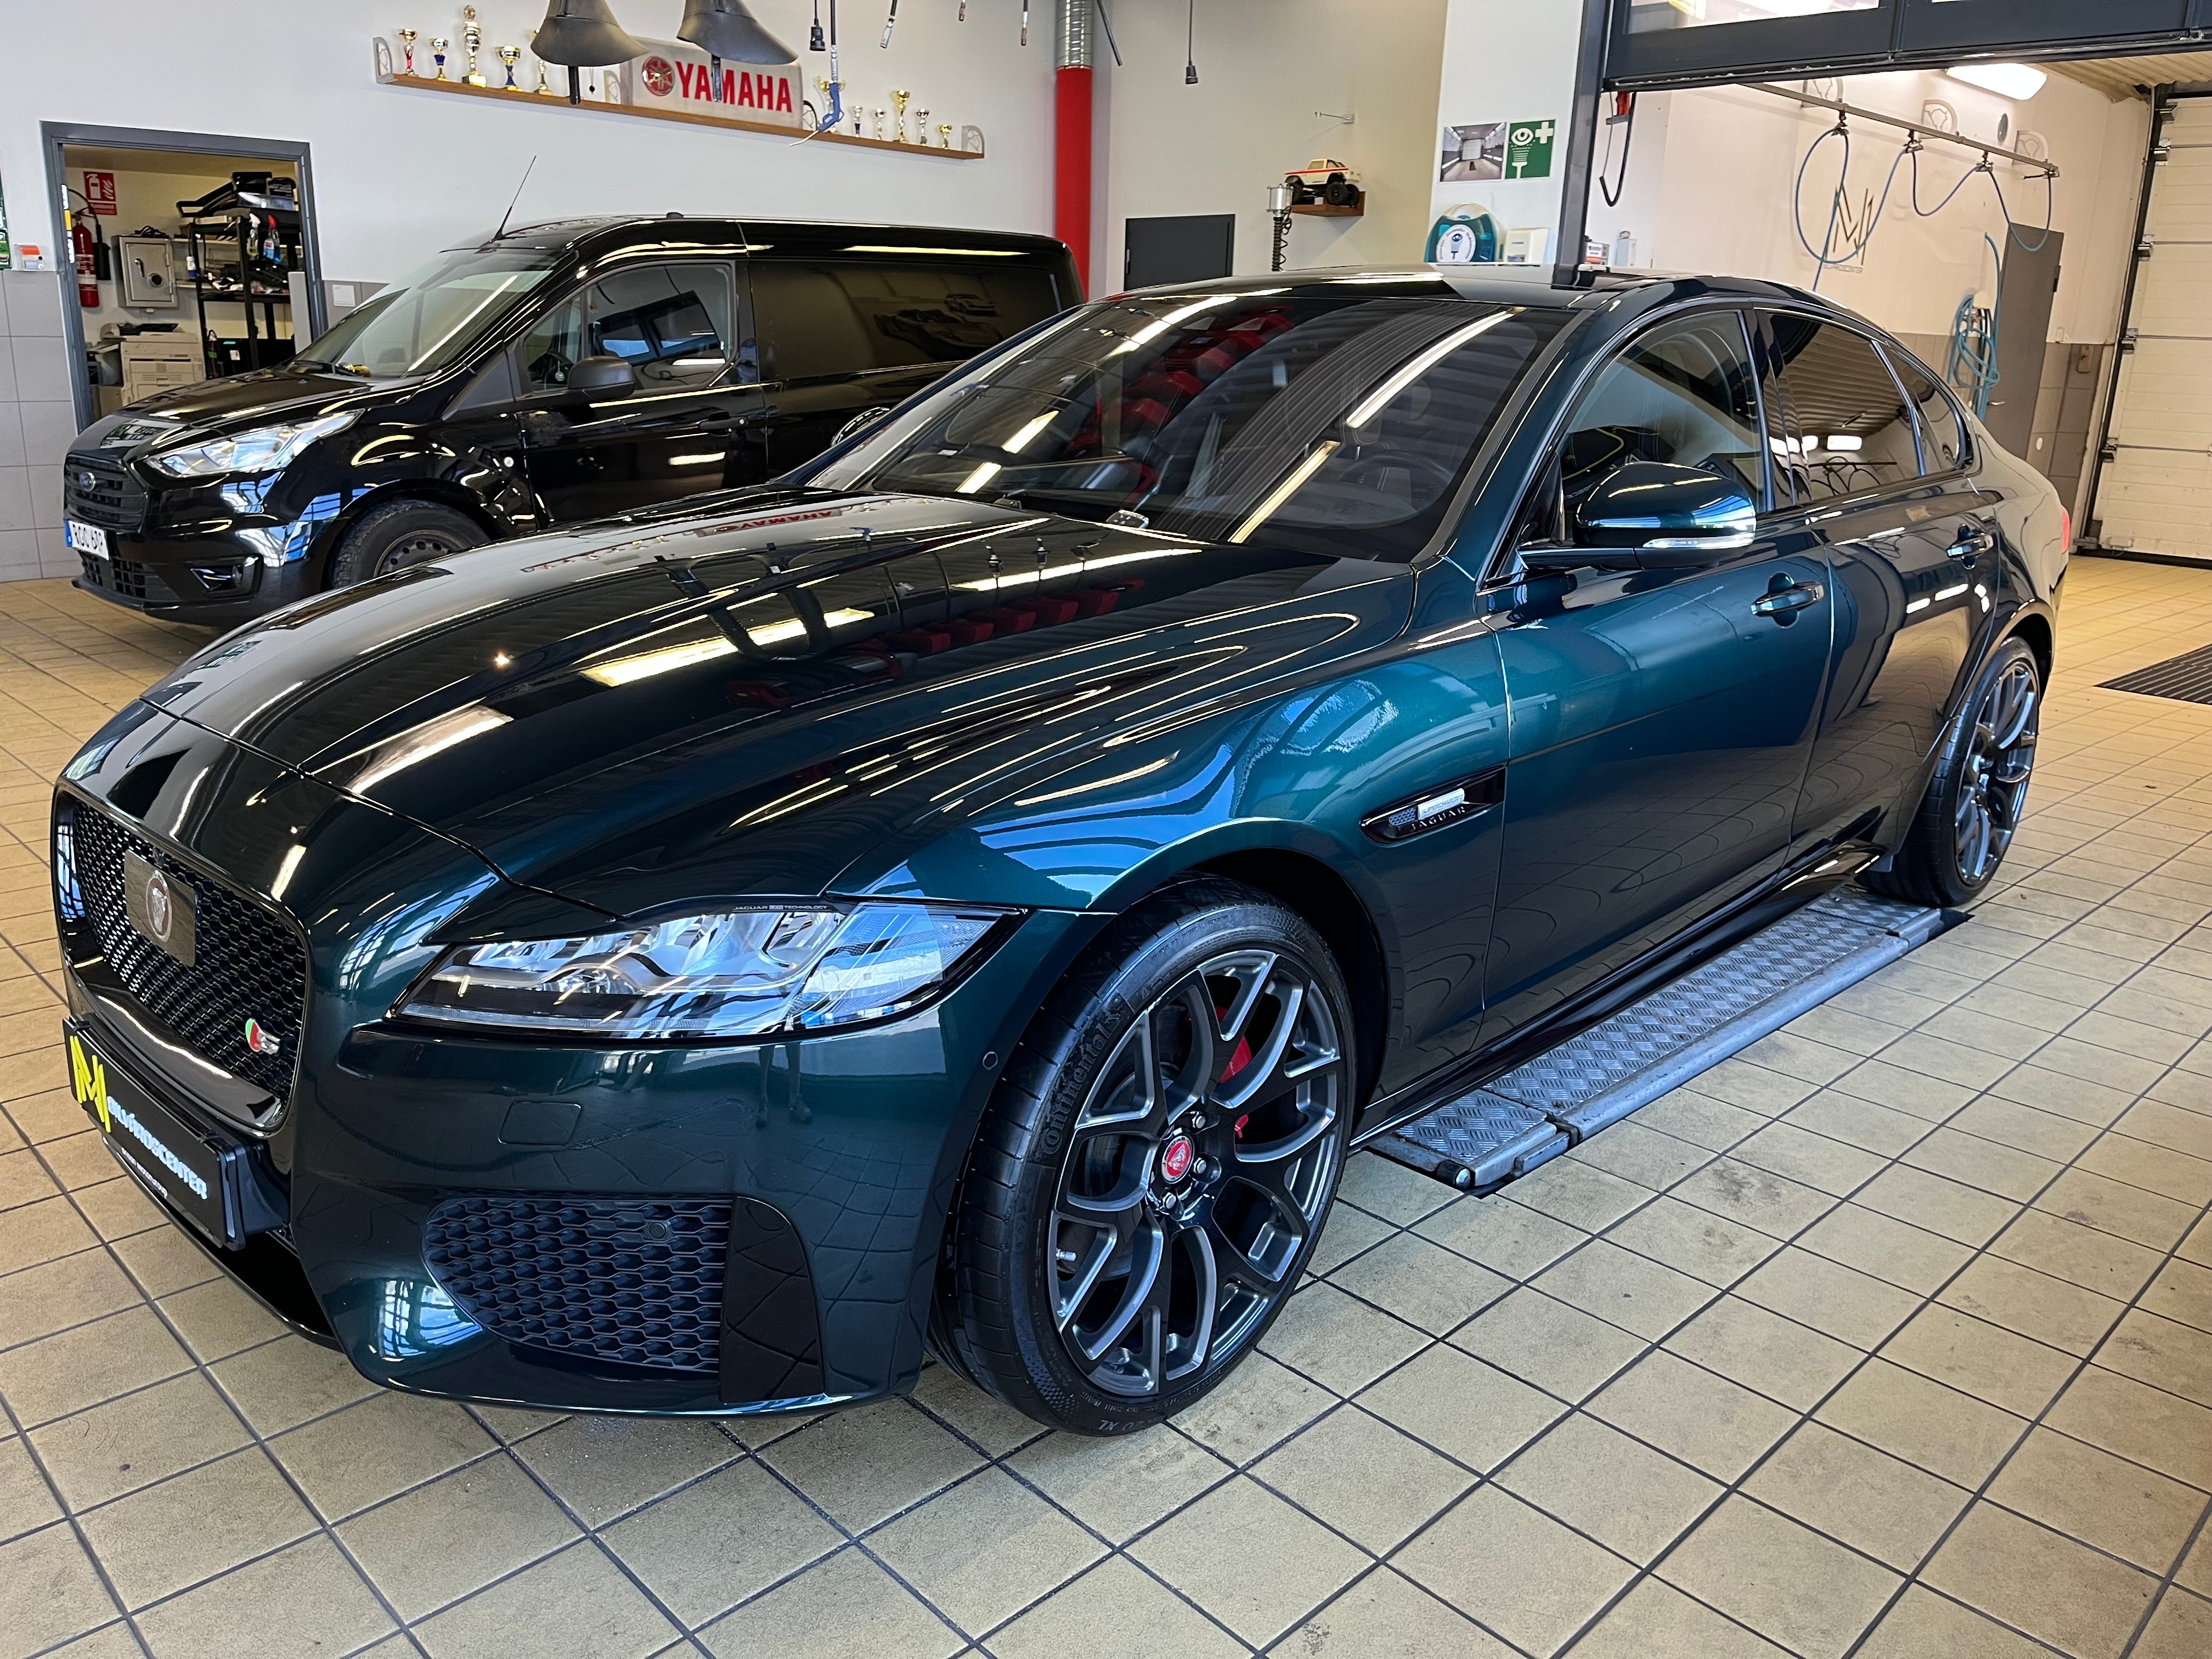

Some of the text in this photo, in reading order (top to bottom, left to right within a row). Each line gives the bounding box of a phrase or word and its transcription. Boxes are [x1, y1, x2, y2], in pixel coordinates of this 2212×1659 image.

[676, 61, 792, 113] YAMAHA
[1410, 806, 1465, 832] JAGUAR
[1421, 794, 1463, 815] SUPERCHARGED
[1040, 1022, 1114, 1155] Continental
